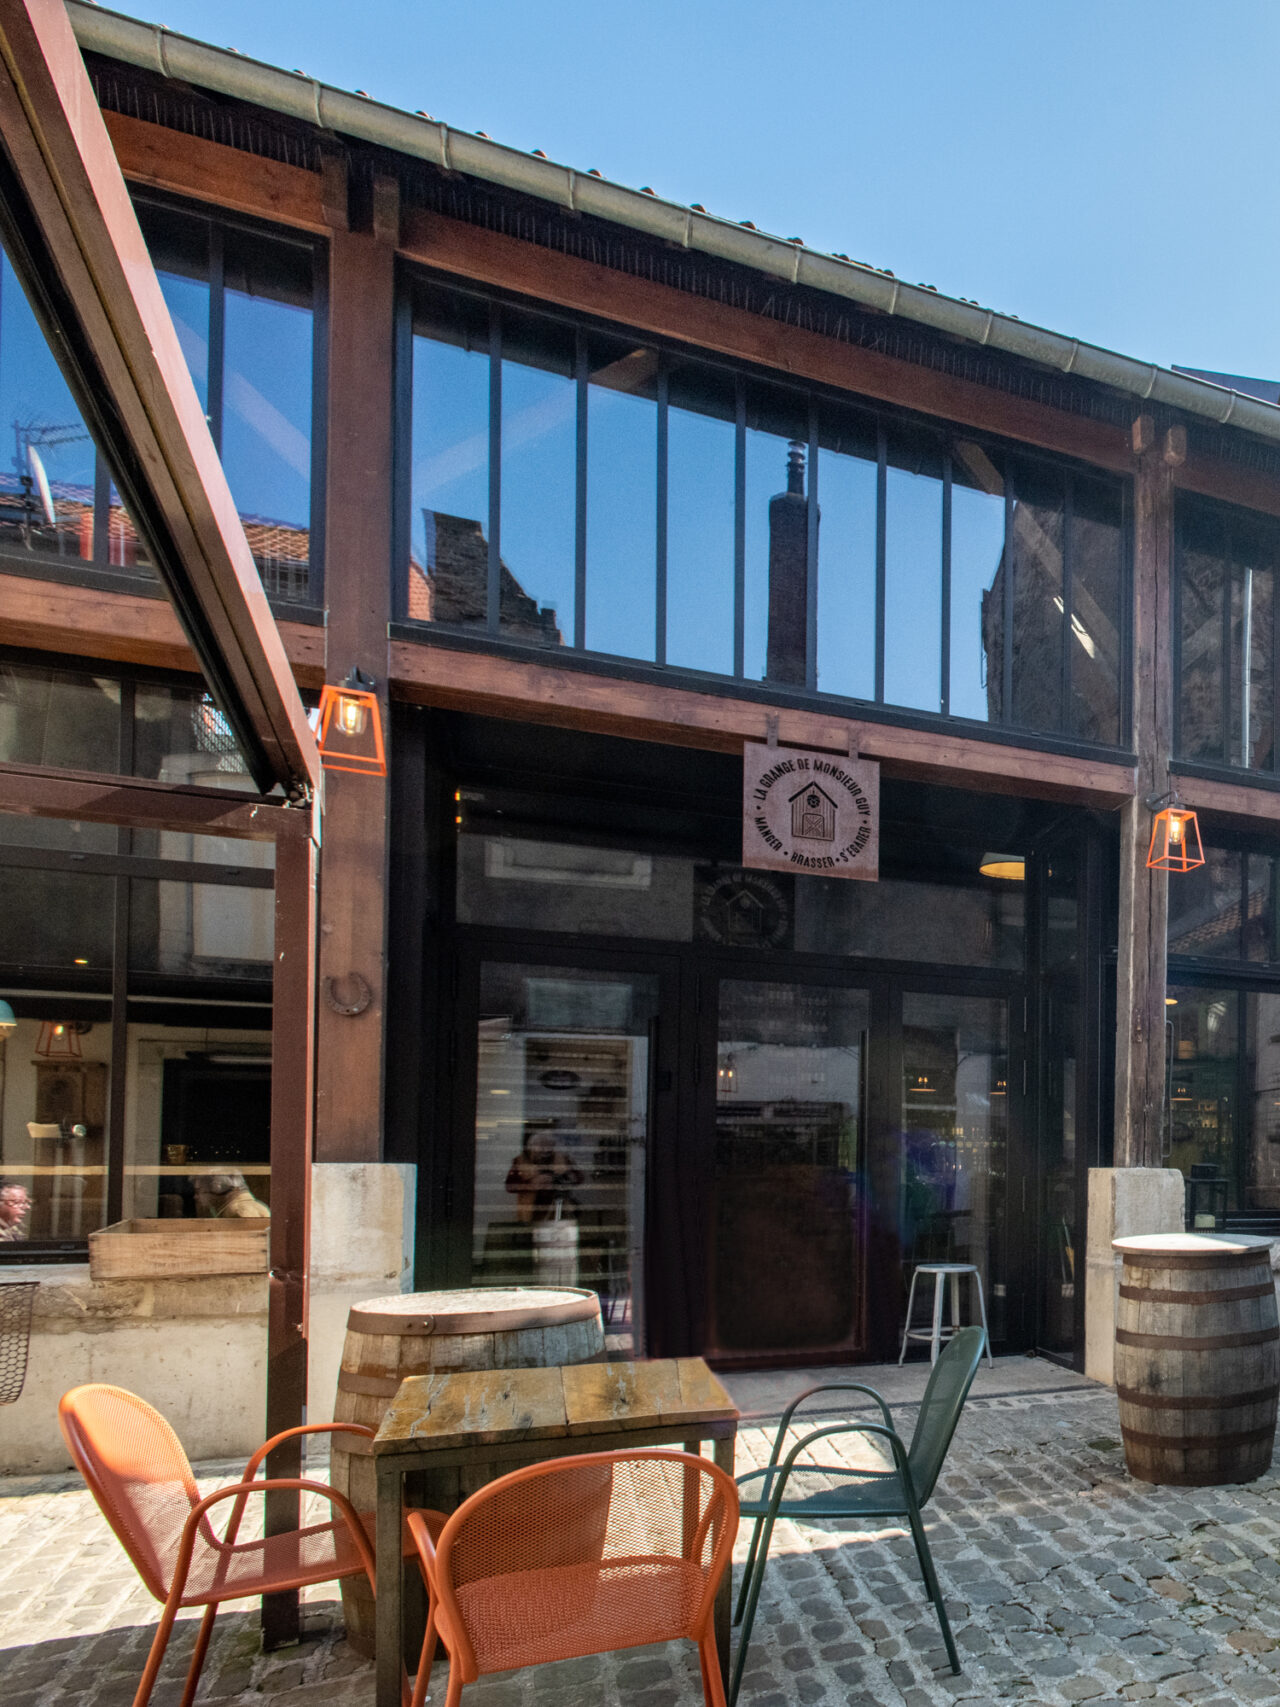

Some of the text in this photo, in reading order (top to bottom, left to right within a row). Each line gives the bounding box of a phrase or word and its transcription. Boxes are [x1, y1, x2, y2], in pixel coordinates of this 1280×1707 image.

[753, 758, 871, 816] LA GRANGE DE MONSIEUR GUY
[754, 816, 783, 851] MANGER
[790, 852, 835, 868] BRASSER
